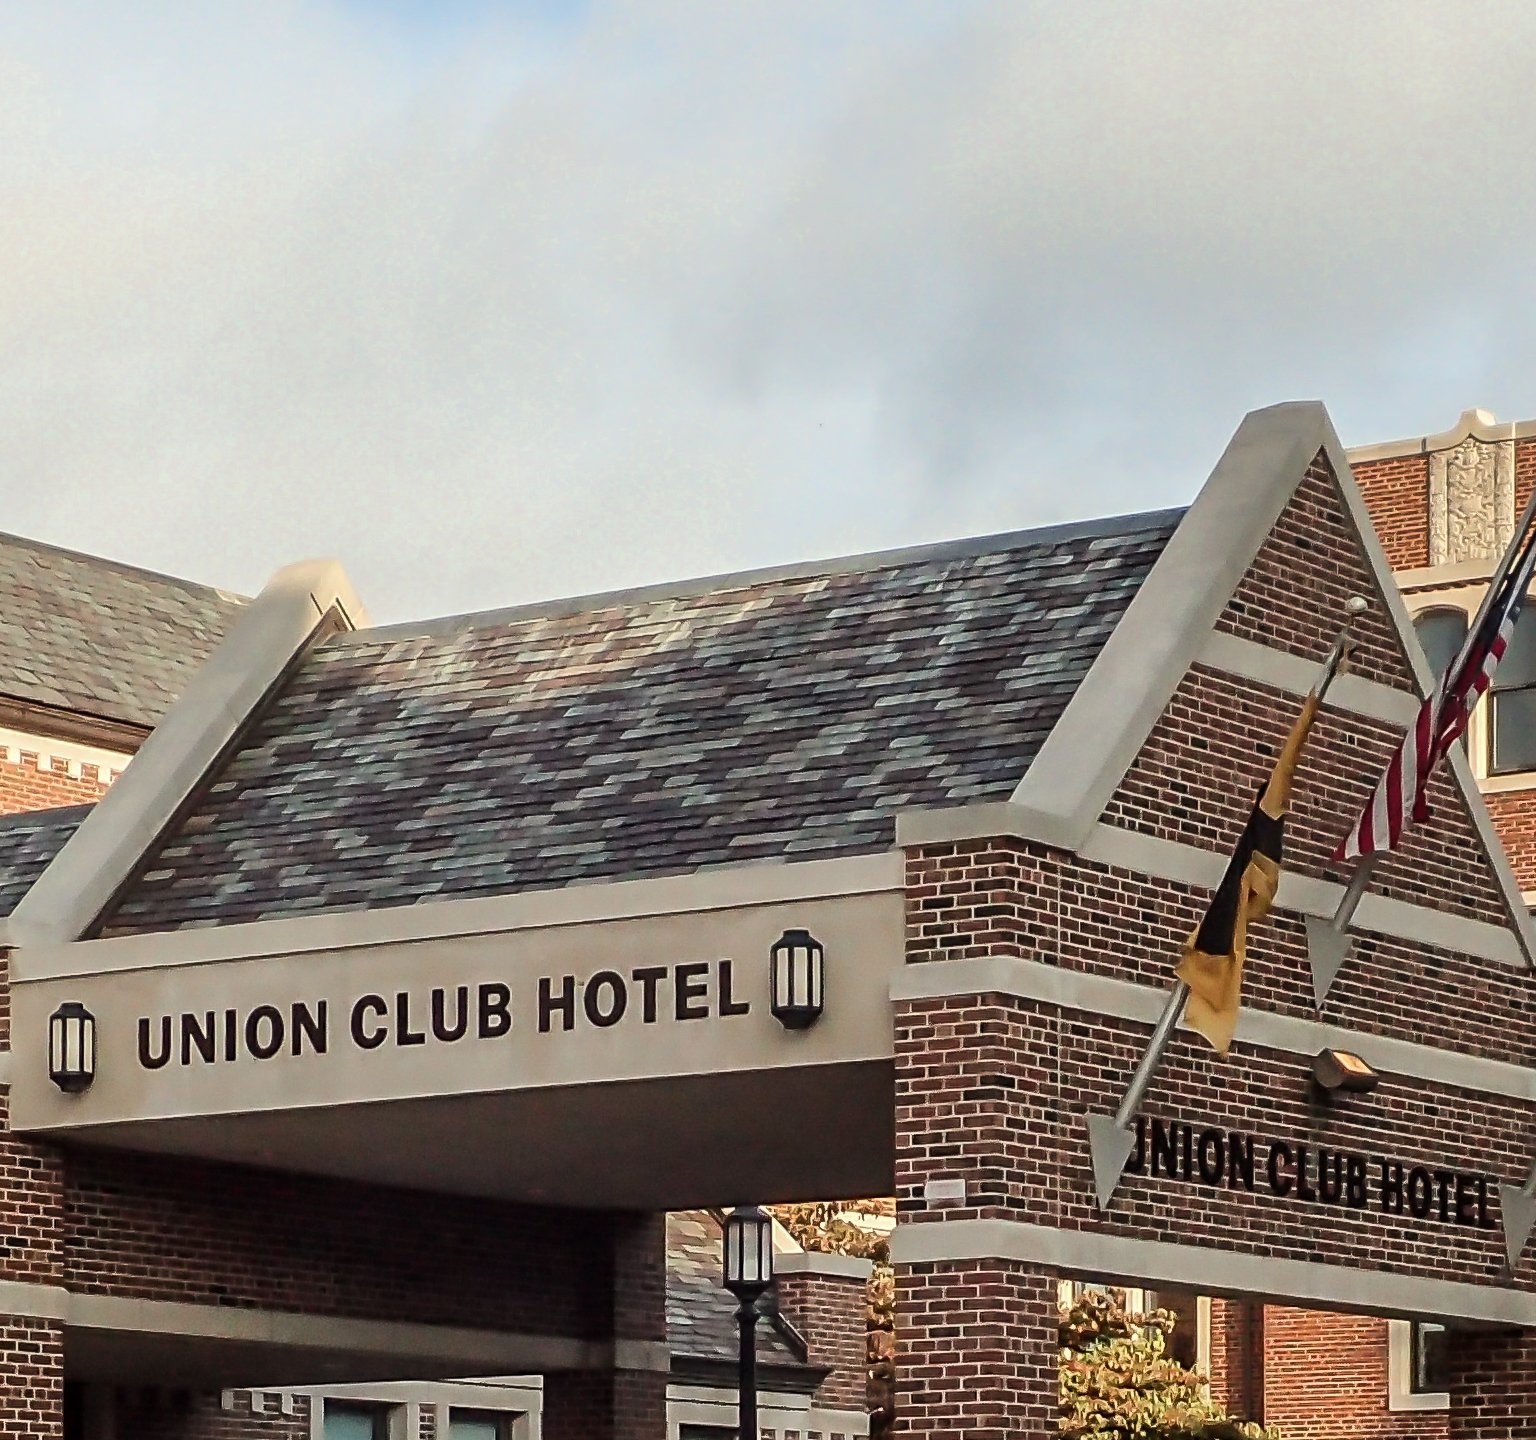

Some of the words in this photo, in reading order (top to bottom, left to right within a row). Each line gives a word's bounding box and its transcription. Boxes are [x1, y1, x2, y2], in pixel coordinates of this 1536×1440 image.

[137, 1000, 328, 1070] UNION
[349, 982, 512, 1050] CLUB
[538, 959, 750, 1034] HOTEL
[1267, 1141, 1366, 1207] CLUB
[1379, 1162, 1496, 1228] HOTEL
